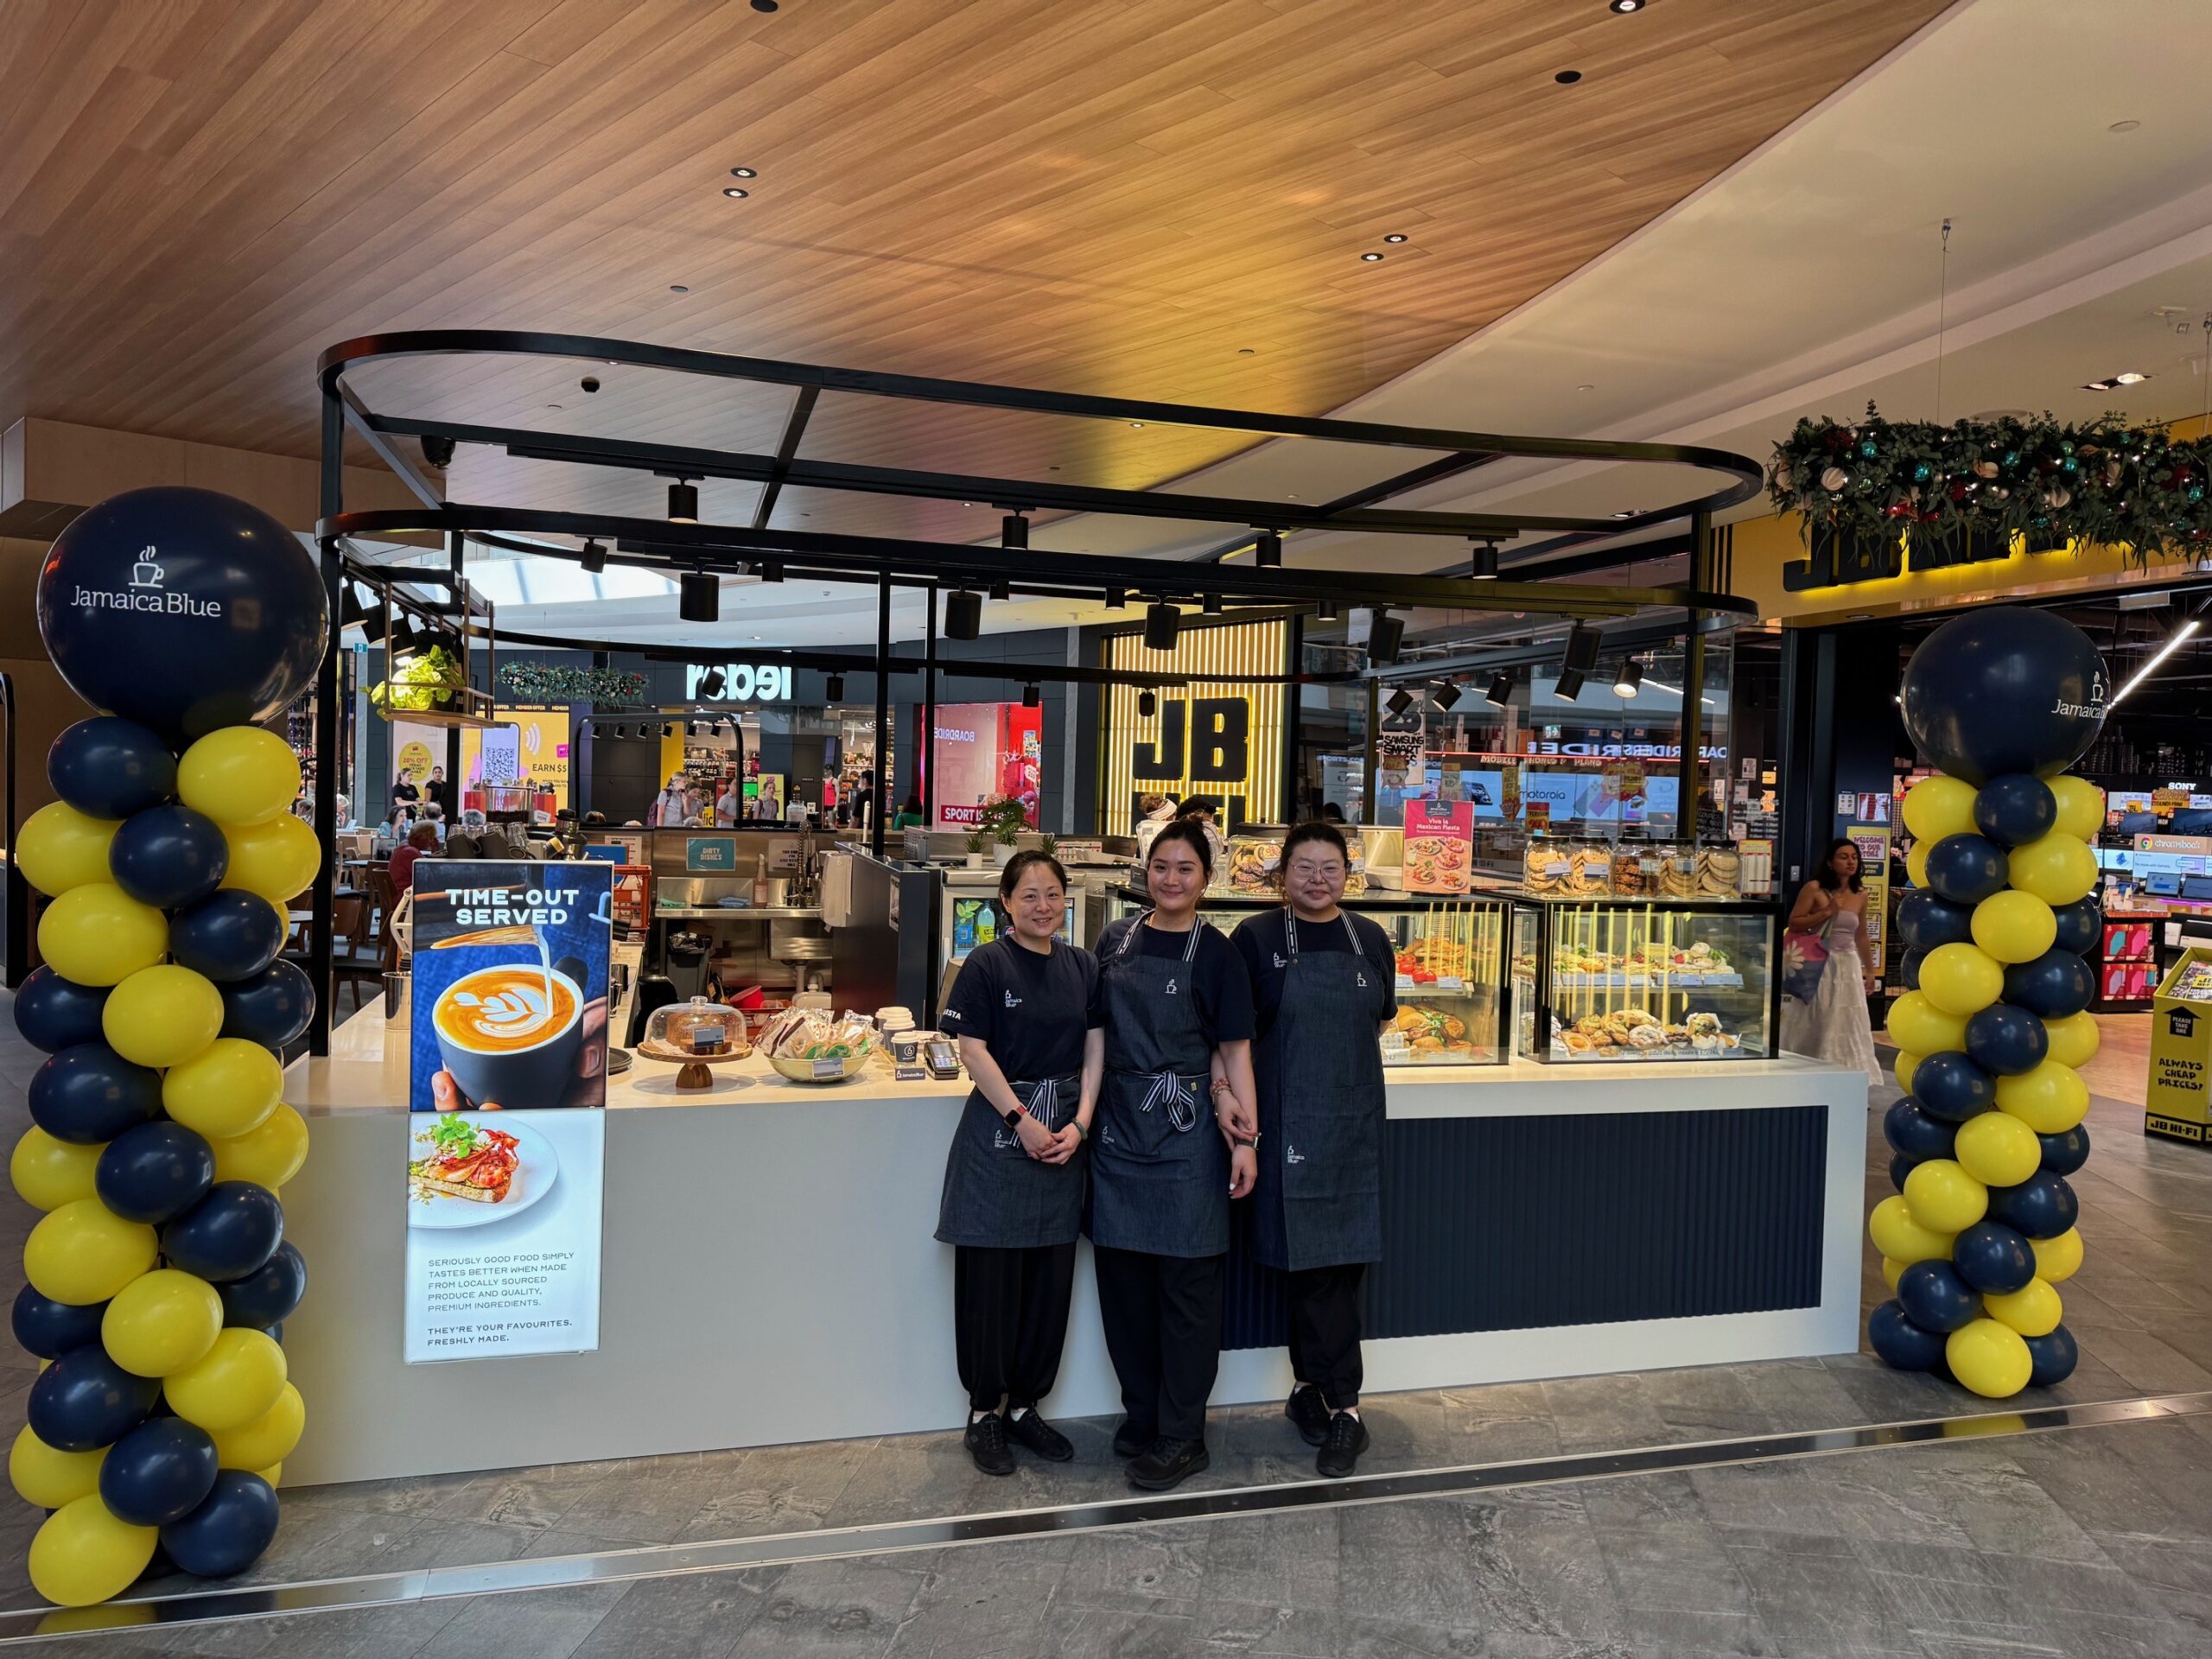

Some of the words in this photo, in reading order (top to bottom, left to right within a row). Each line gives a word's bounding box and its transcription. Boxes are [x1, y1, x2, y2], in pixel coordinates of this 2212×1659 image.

[1133, 697, 1249, 782] JB
[1384, 735, 1424, 744] SAMSUNG
[1383, 745, 1421, 754] SMART
[1480, 755, 1517, 766] MOBILE
[2168, 782, 2196, 791] SONY
[1519, 790, 1566, 800] motorola
[945, 808, 975, 821] SPORT
[2155, 838, 2200, 849] chromebook
[445, 889, 579, 906] TIME-OUT
[456, 909, 569, 925] SERVED
[943, 1009, 961, 1020] ISTA
[2172, 1016, 2191, 1025] PLEASE
[2158, 1058, 2203, 1071] ALWAYS
[2164, 1069, 2196, 1080] CHEAP
[2158, 1077, 2203, 1090] PRICES!
[2150, 1117, 2168, 1130] JB
[429, 1257, 481, 1267] SERIOUSLY
[543, 1252, 574, 1261] SIMPLY
[429, 1269, 466, 1278] TASTES
[511, 1265, 537, 1274] WHEN
[541, 1263, 567, 1272] MADE
[458, 1279, 499, 1287] LOCALLY
[501, 1277, 548, 1286] SOURCED
[429, 1292, 475, 1301] PRODUCE
[501, 1287, 543, 1297] QUALITY,
[429, 1303, 472, 1312] PREMIUM
[475, 1300, 542, 1309] INGREDIENTS.
[428, 1325, 474, 1335] THEY'RE
[476, 1324, 503, 1332] YOUR
[506, 1319, 573, 1331] FAVOURITES.
[427, 1337, 475, 1346] FRESHLY
[479, 1334, 510, 1343] MADE.
